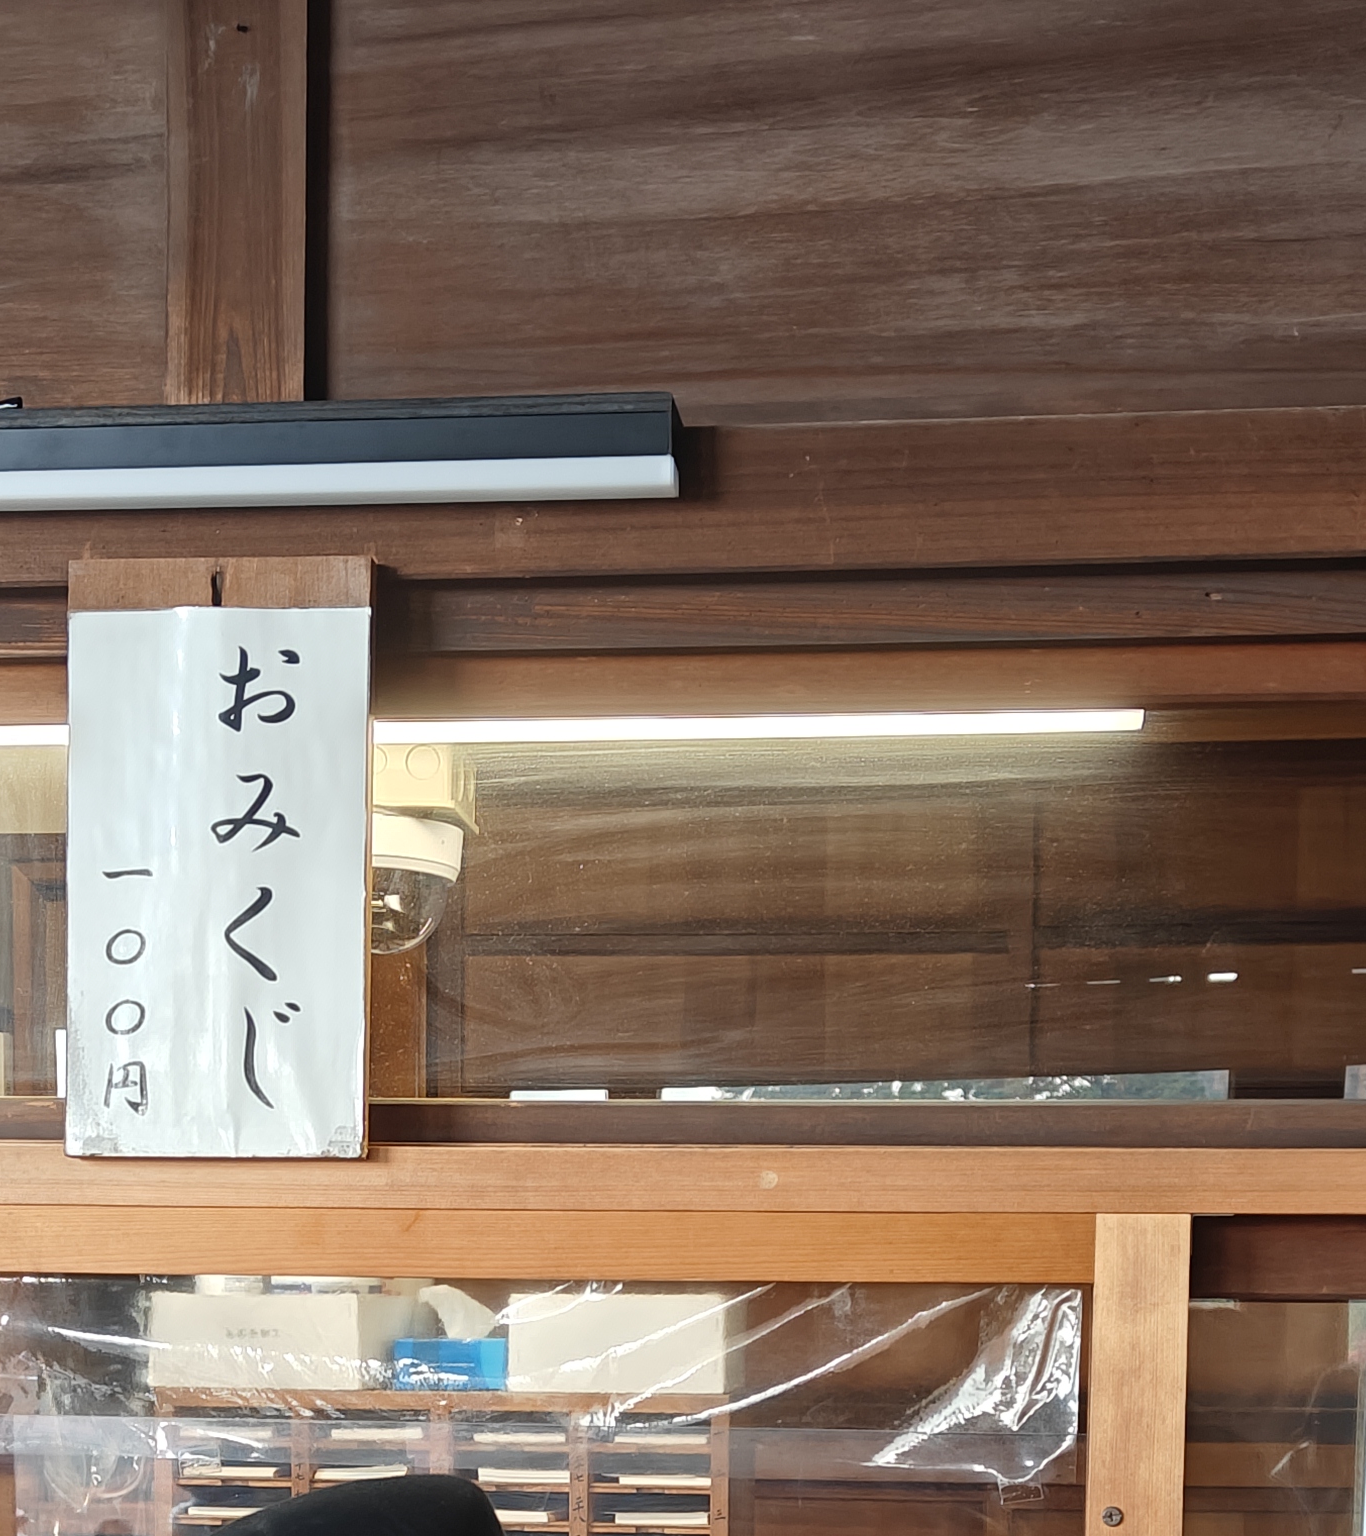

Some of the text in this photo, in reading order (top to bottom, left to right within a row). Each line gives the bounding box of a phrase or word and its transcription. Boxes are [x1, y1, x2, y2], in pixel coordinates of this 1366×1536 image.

[210, 645, 302, 1110] おみくじ
[572, 1497, 585, 1523] 二十八
[714, 1509, 726, 1521] 三
